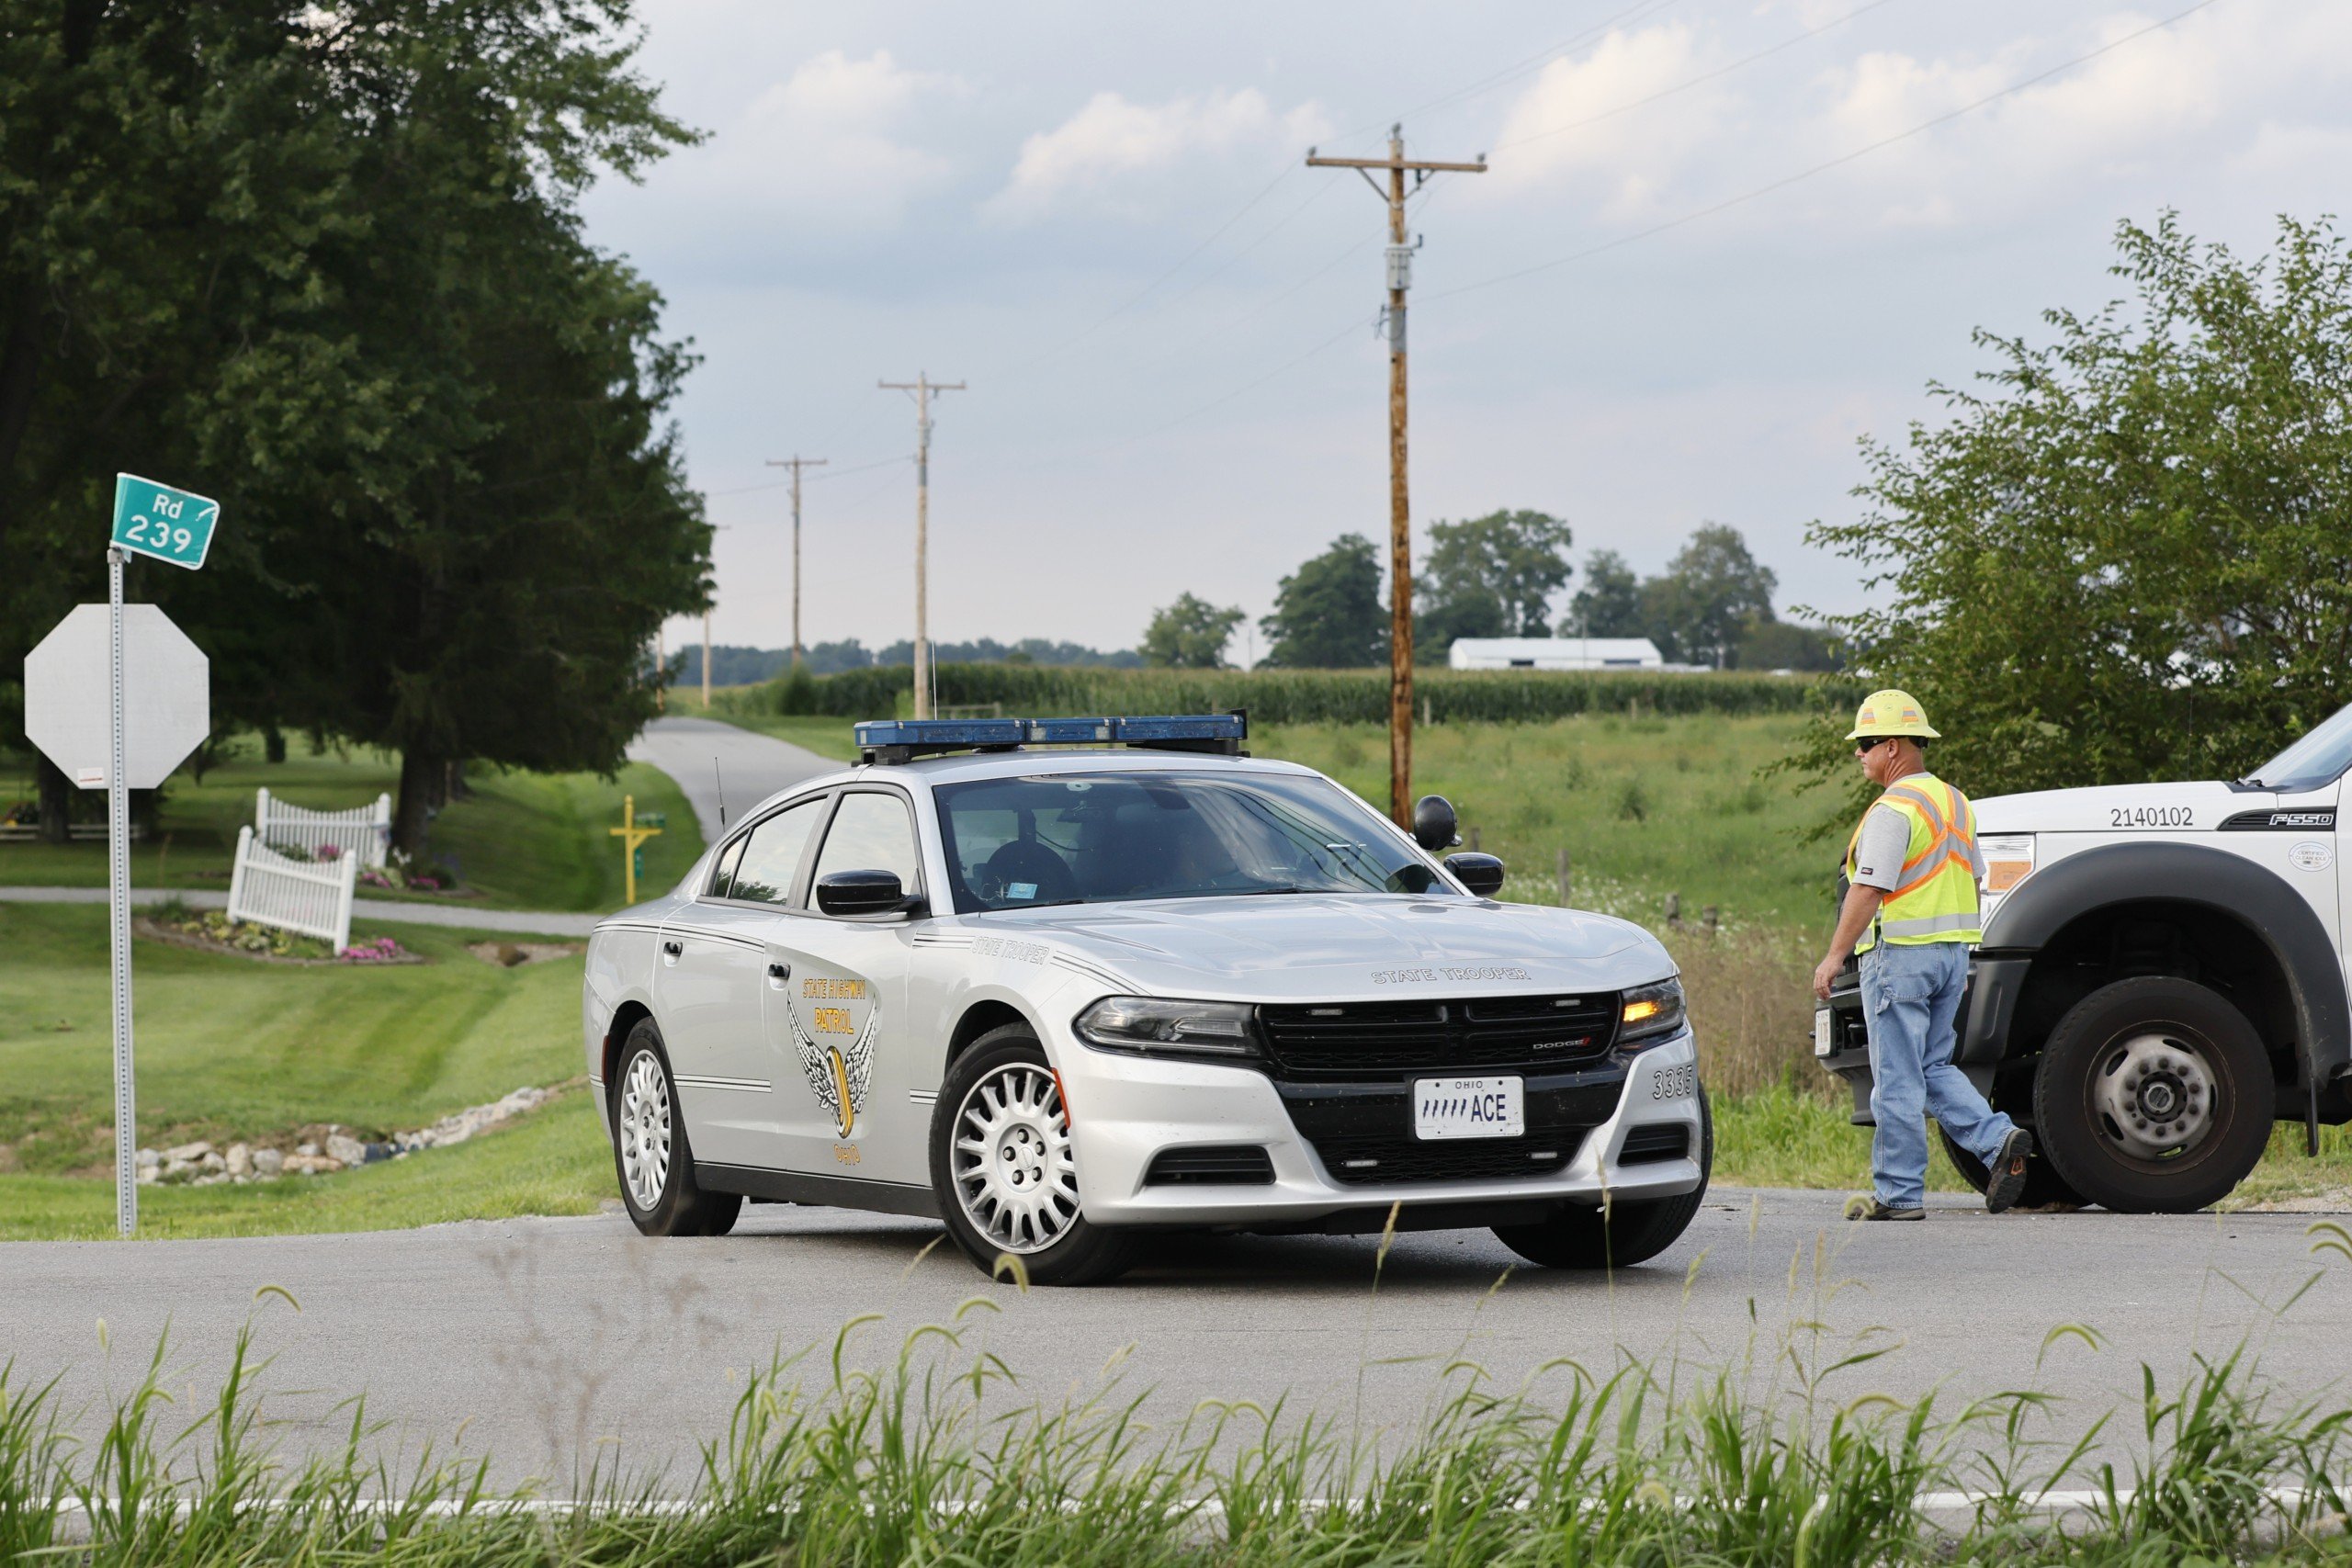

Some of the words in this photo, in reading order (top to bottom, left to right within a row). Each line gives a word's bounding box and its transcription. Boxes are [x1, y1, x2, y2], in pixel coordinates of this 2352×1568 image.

[153, 493, 184, 519] Rd
[125, 514, 192, 554] 239
[2110, 807, 2194, 827] 2140102
[972, 936, 1004, 956] STATE
[1001, 940, 1049, 964] TROOPER
[1372, 969, 1437, 985] STATE
[1440, 967, 1532, 981] TROOPER
[803, 978, 827, 998] STATE
[828, 978, 865, 999] HIGHWAY
[814, 1007, 854, 1034] PATROL
[1532, 1039, 1584, 1049] DODGE
[1455, 1080, 1484, 1089] OHIO
[1653, 1065, 1692, 1100] 3335
[834, 1144, 861, 1165] OHIO
